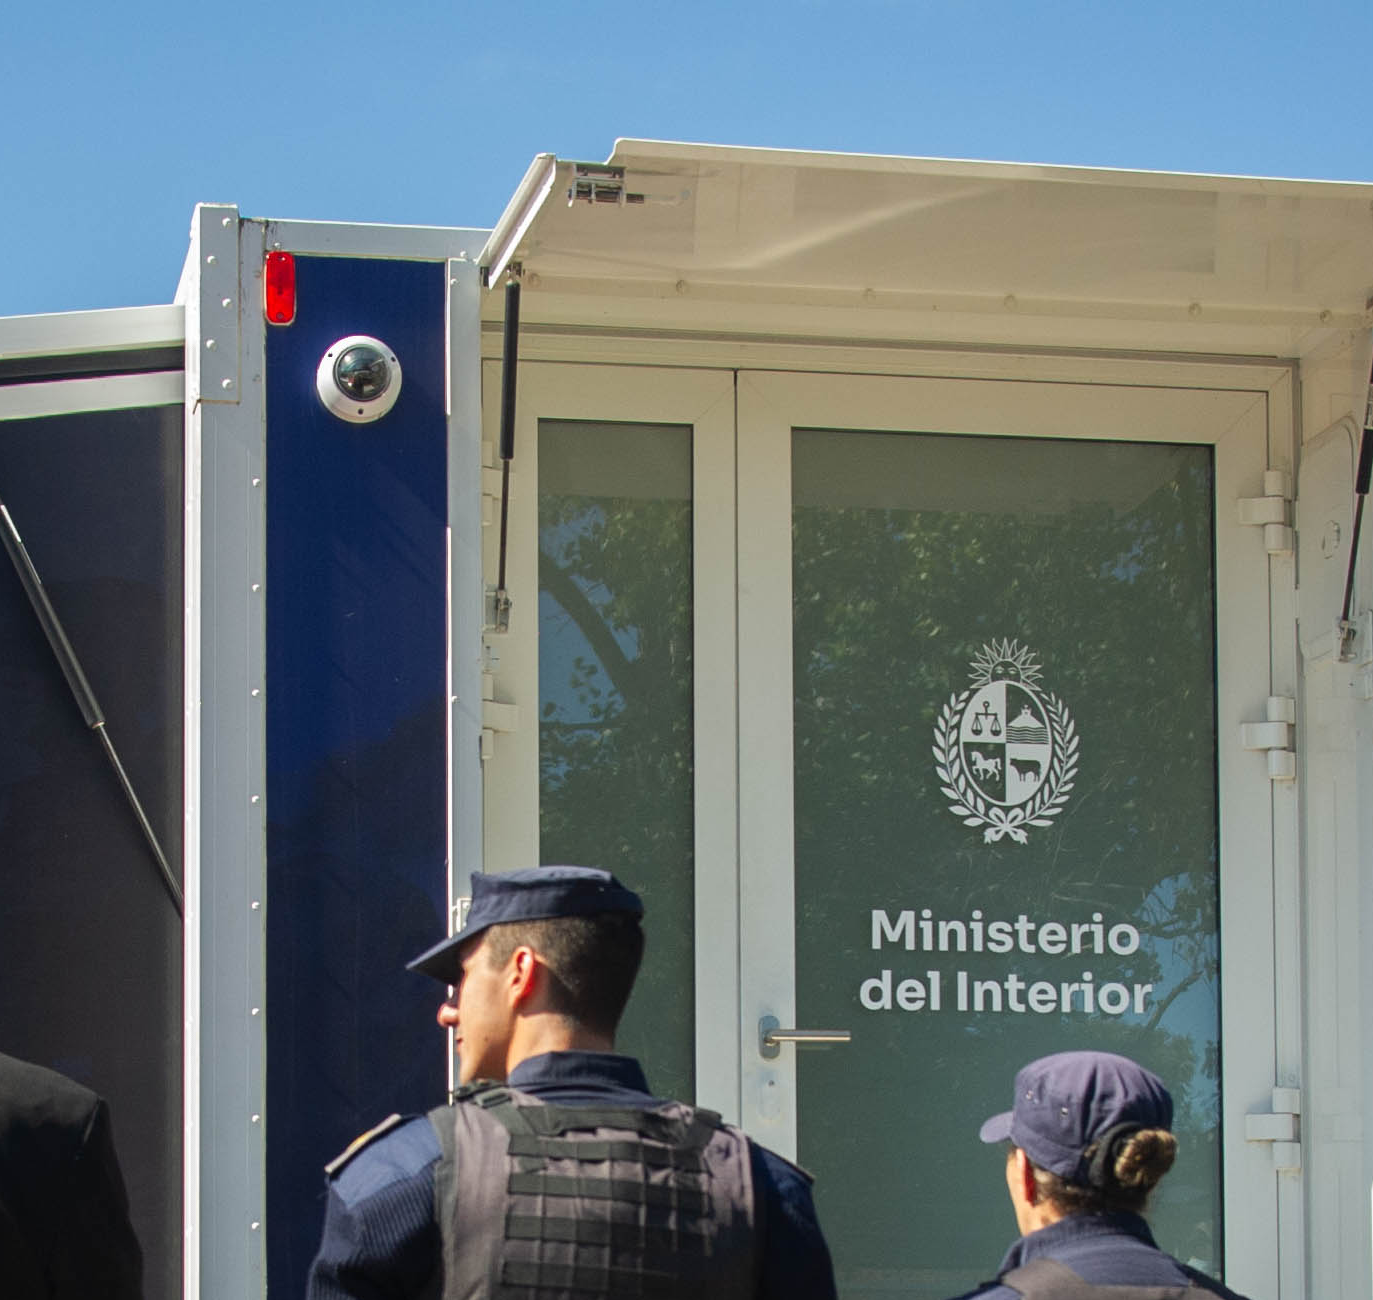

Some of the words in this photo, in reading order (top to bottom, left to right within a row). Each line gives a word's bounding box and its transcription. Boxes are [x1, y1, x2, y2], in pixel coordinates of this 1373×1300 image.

[871, 910, 1140, 956] Ministerio
[859, 970, 942, 1012] del
[957, 972, 1154, 1015] Interior
